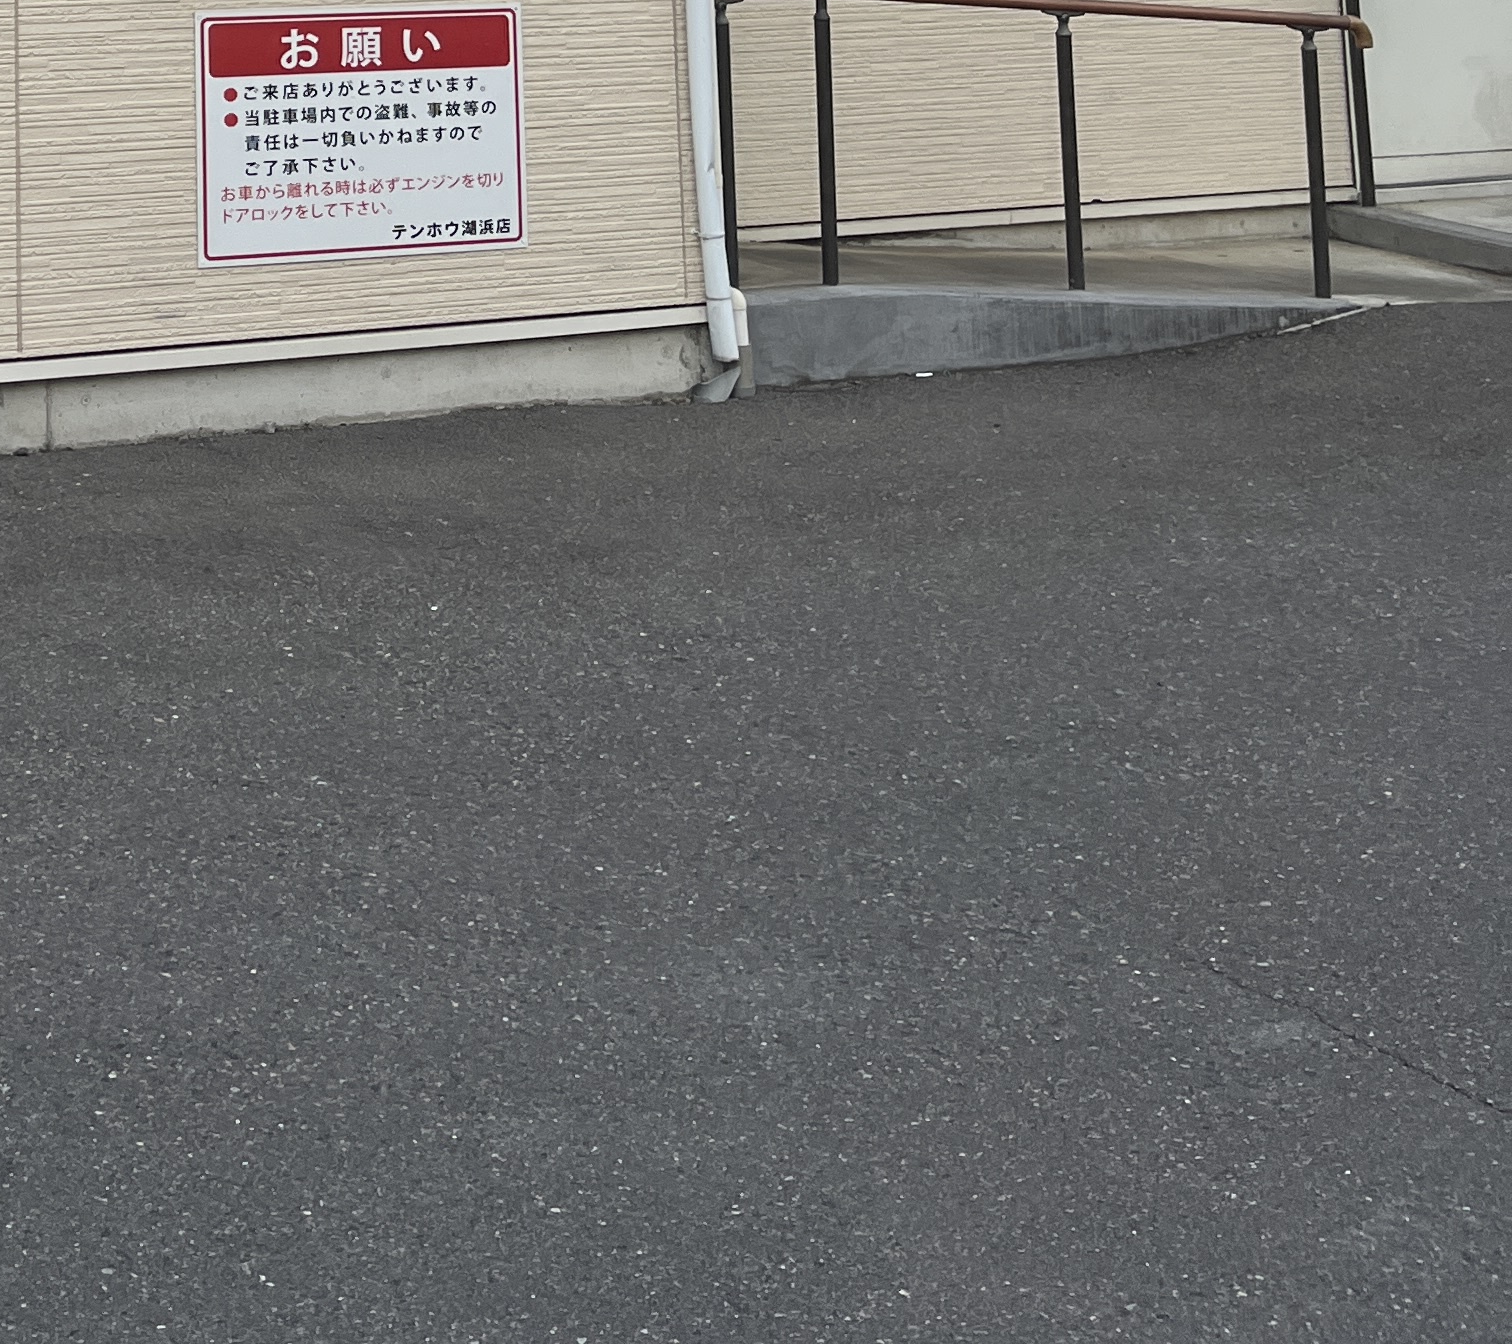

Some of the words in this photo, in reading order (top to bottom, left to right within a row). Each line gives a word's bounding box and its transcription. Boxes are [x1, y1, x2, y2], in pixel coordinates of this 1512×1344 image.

[279, 25, 442, 70] お願い
[243, 76, 486, 101] ご来店ありがとうございます。
[244, 99, 497, 127] 当駐車場内での盗難、事故等の
[244, 124, 483, 152] 責任は一切負いかねますので
[244, 156, 365, 178] ご了承下さい。
[220, 171, 505, 202] お車から離れる時は必ずエンジンを切り
[221, 201, 393, 224] ドアロックをして下さい。
[391, 217, 511, 240] テンホウ湖浜店
